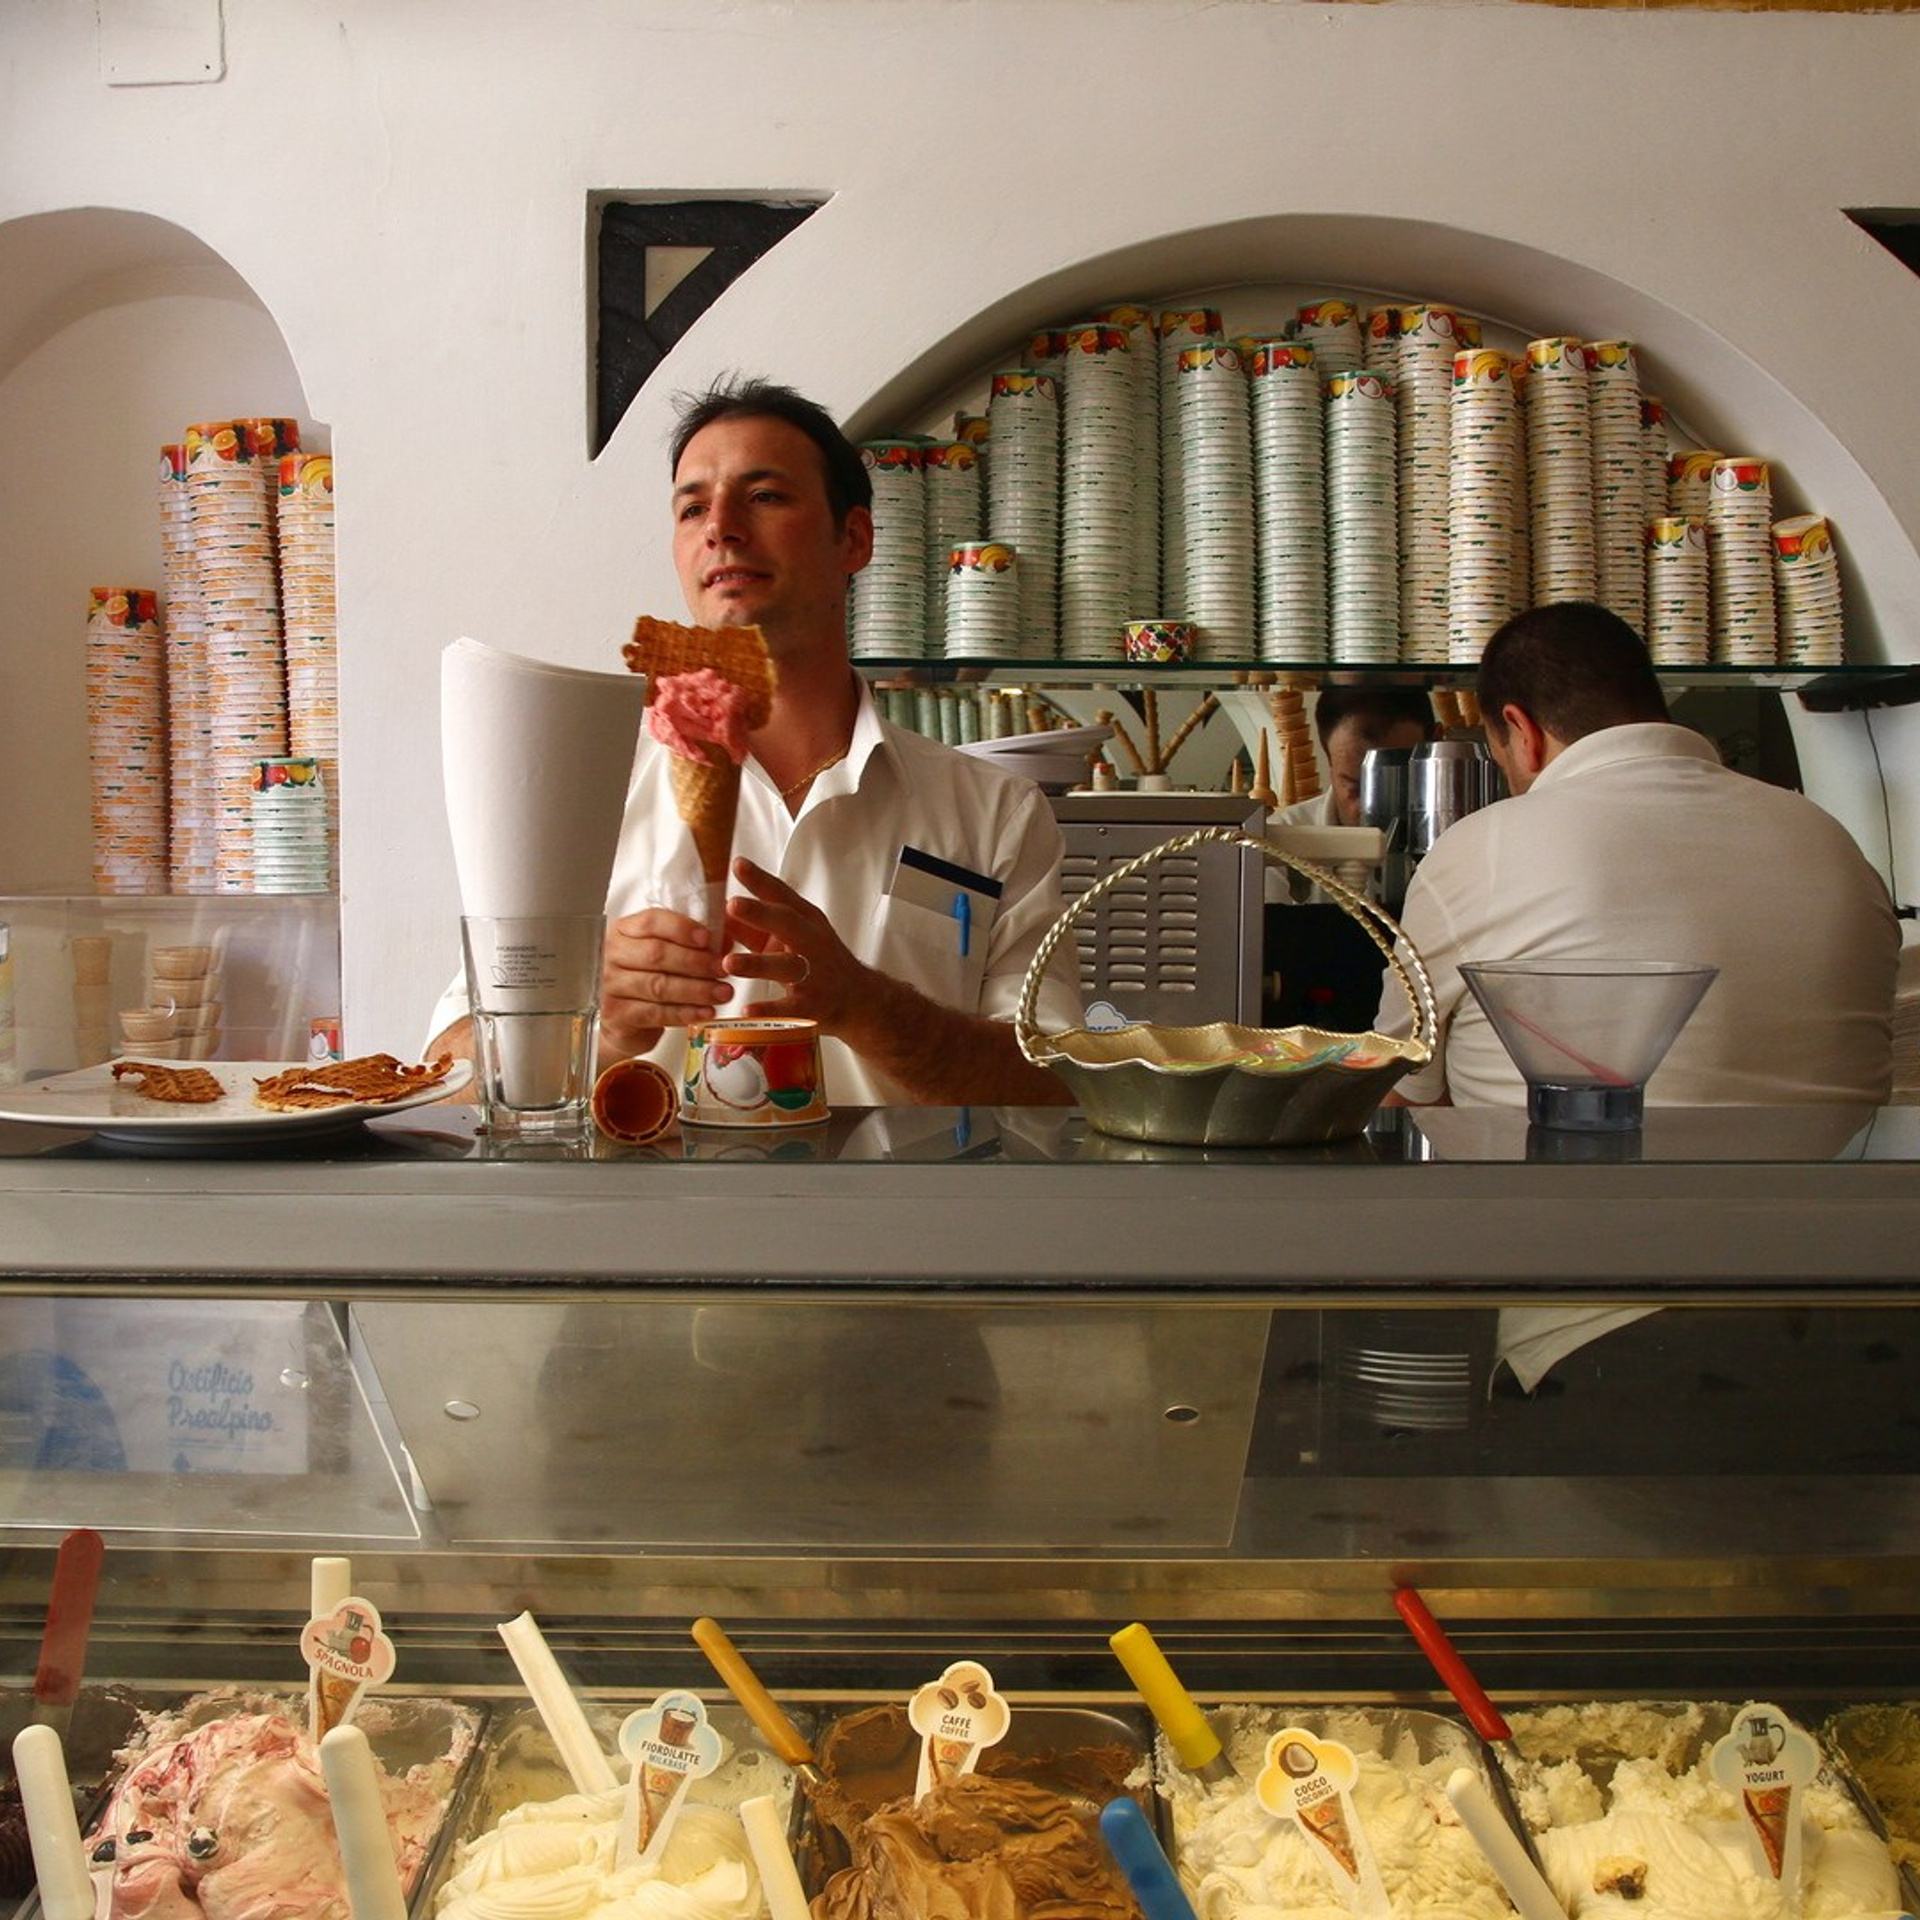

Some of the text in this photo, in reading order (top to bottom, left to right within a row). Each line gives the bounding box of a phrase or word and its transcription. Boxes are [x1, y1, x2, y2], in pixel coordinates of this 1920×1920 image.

[314, 1648, 374, 1678] SPAGNOLA
[940, 1725, 970, 1738] COFFEE
[641, 1740, 701, 1765] FIORDILATTE
[1294, 1776, 1328, 1797] COCCO
[1745, 1770, 1785, 1784] YOGURT
[1296, 1785, 1334, 1807] COCONUT
